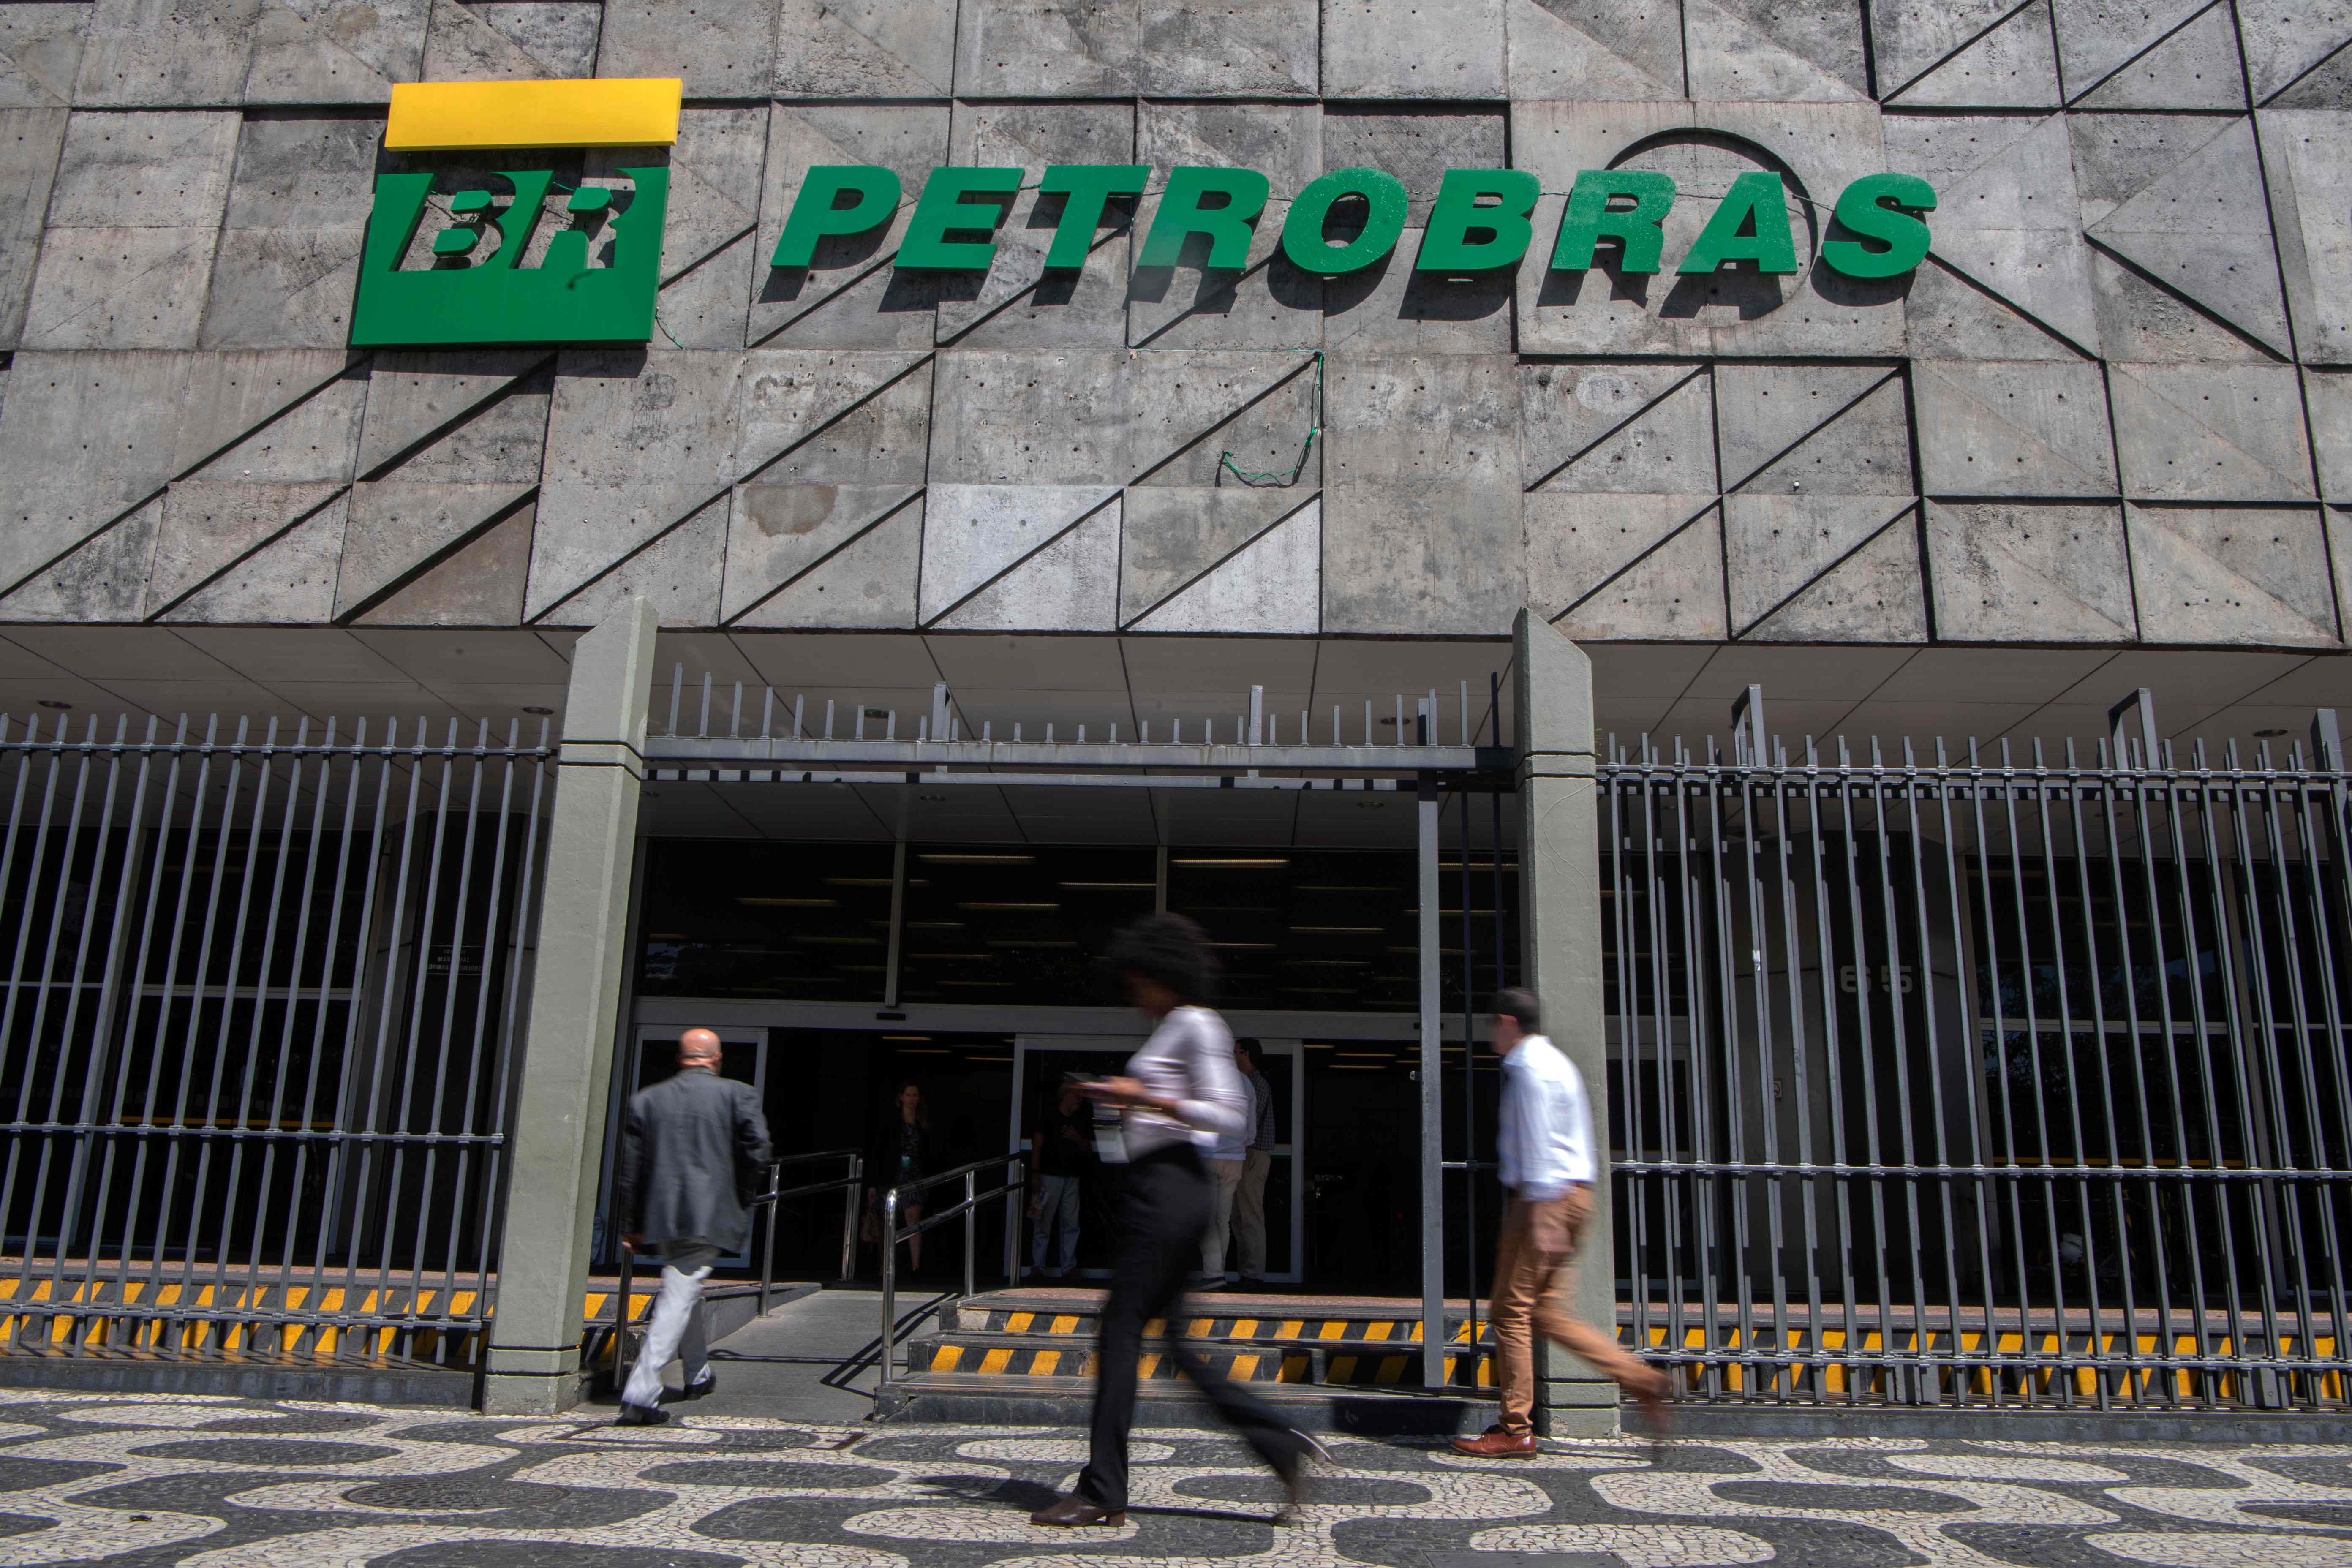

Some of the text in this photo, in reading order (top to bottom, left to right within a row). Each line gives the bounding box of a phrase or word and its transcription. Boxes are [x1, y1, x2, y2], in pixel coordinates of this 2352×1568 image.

[389, 169, 635, 272] BR
[772, 166, 1937, 278] PETROBRAS
[1840, 965, 1913, 993] 65
